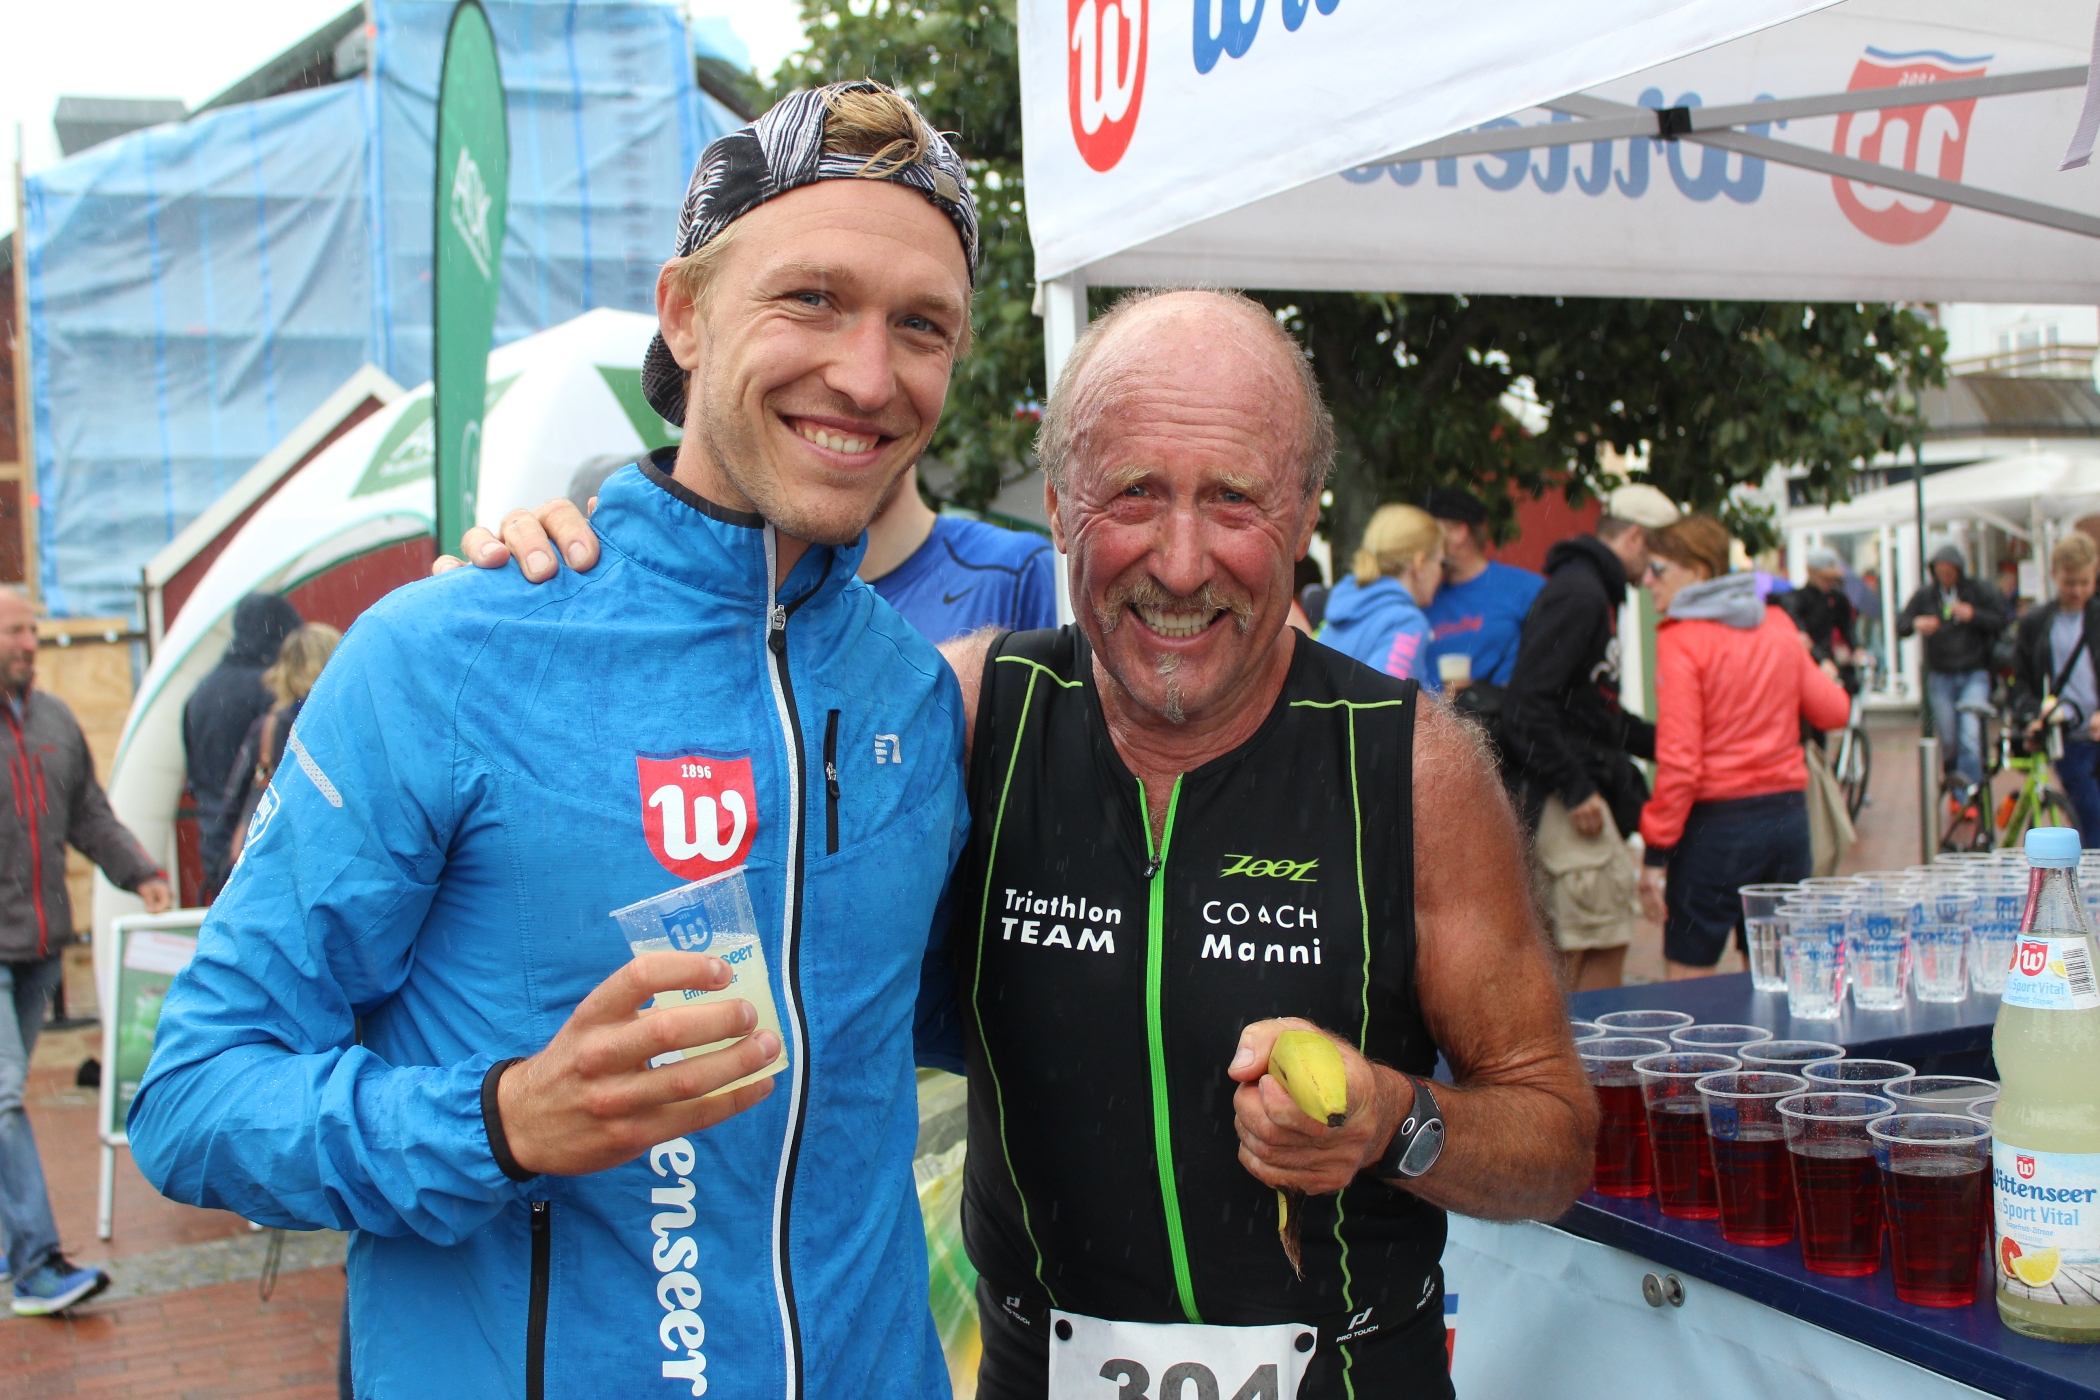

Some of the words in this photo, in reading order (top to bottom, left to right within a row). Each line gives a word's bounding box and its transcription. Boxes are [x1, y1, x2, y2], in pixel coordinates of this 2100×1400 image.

[681, 764, 712, 779] 1896
[1005, 888, 1122, 925] Triathlon
[1202, 900, 1318, 929] COACH
[1001, 916, 1116, 954] TEAM
[1201, 933, 1321, 965] Manni
[2012, 978, 2035, 994] Sport
[2038, 982, 2064, 996] Vital
[2003, 1197, 2036, 1221] Sport
[2040, 1206, 2079, 1226] Vital
[1336, 1333, 1352, 1343] PRO
[1353, 1324, 1379, 1337] TOUCH
